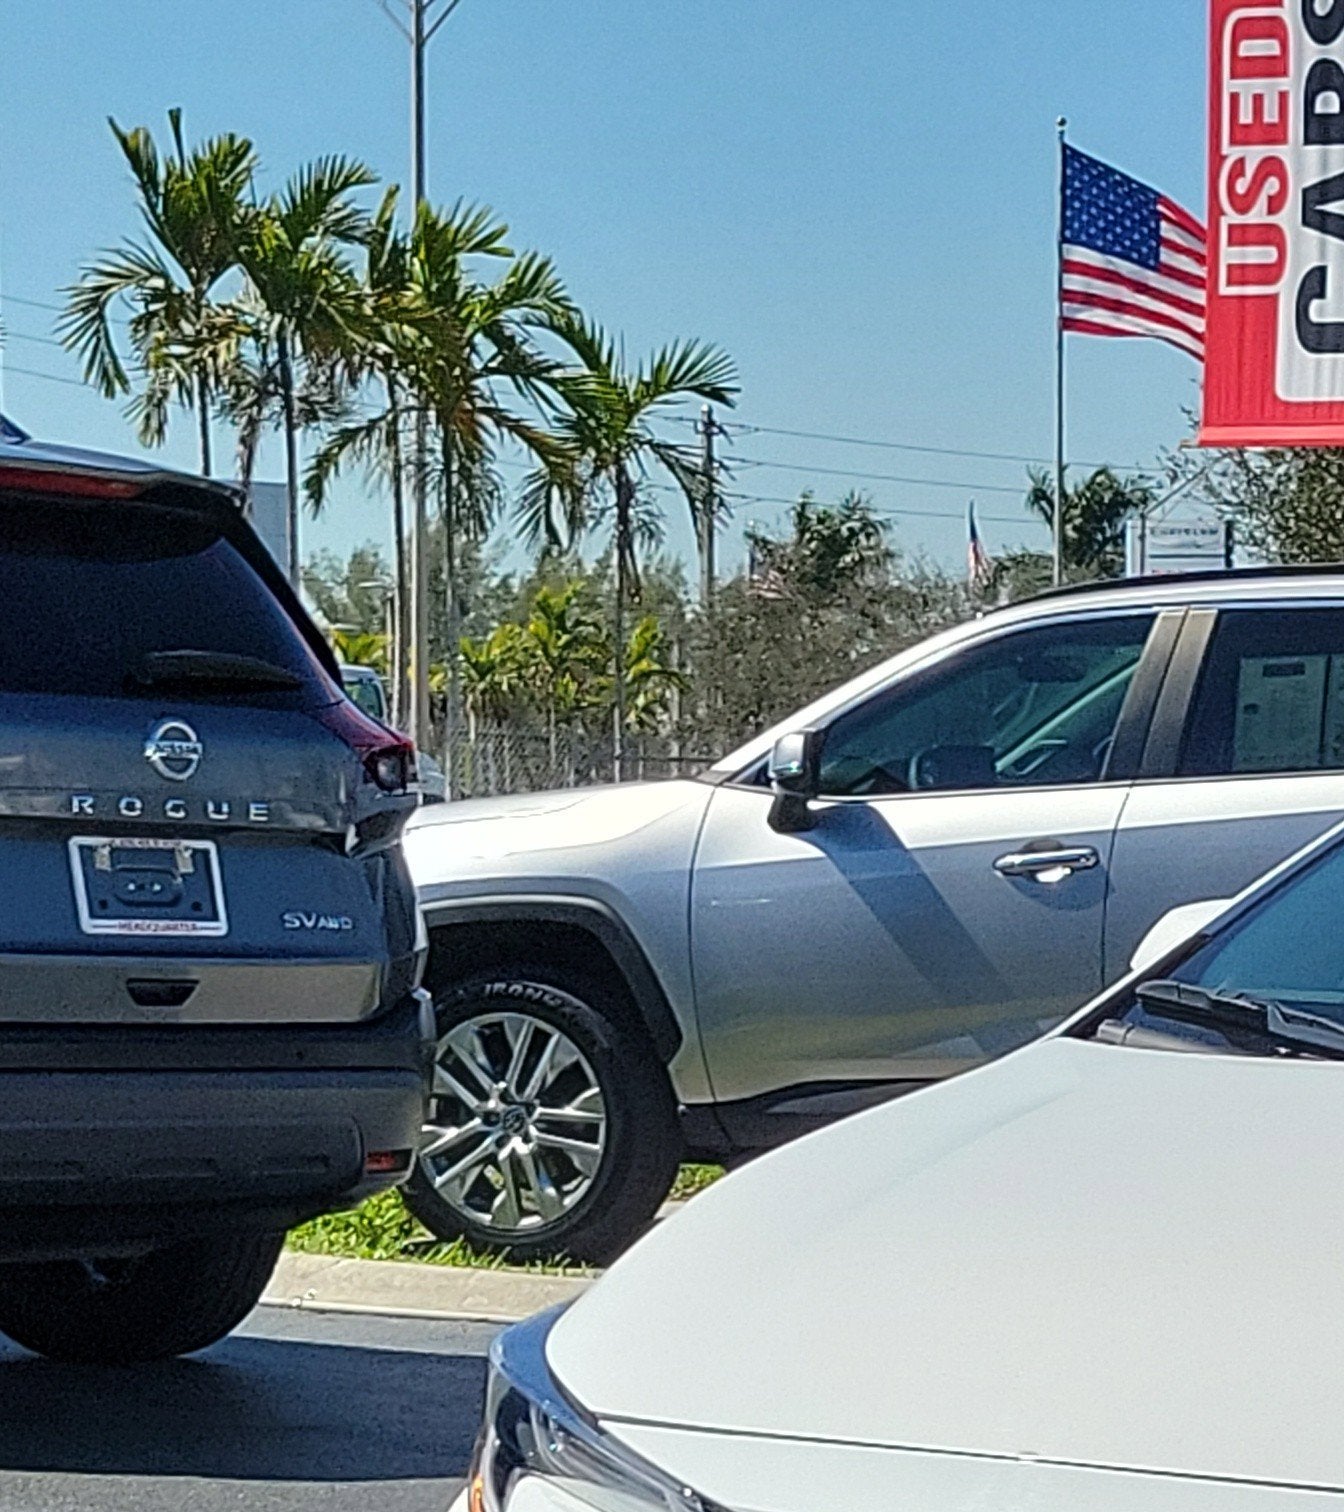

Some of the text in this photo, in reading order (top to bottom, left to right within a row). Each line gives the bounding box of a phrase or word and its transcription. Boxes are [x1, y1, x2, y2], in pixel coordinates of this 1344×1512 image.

[1225, 15, 1290, 289] USED
[71, 795, 269, 822] ROGUE
[283, 911, 317, 928] SV
